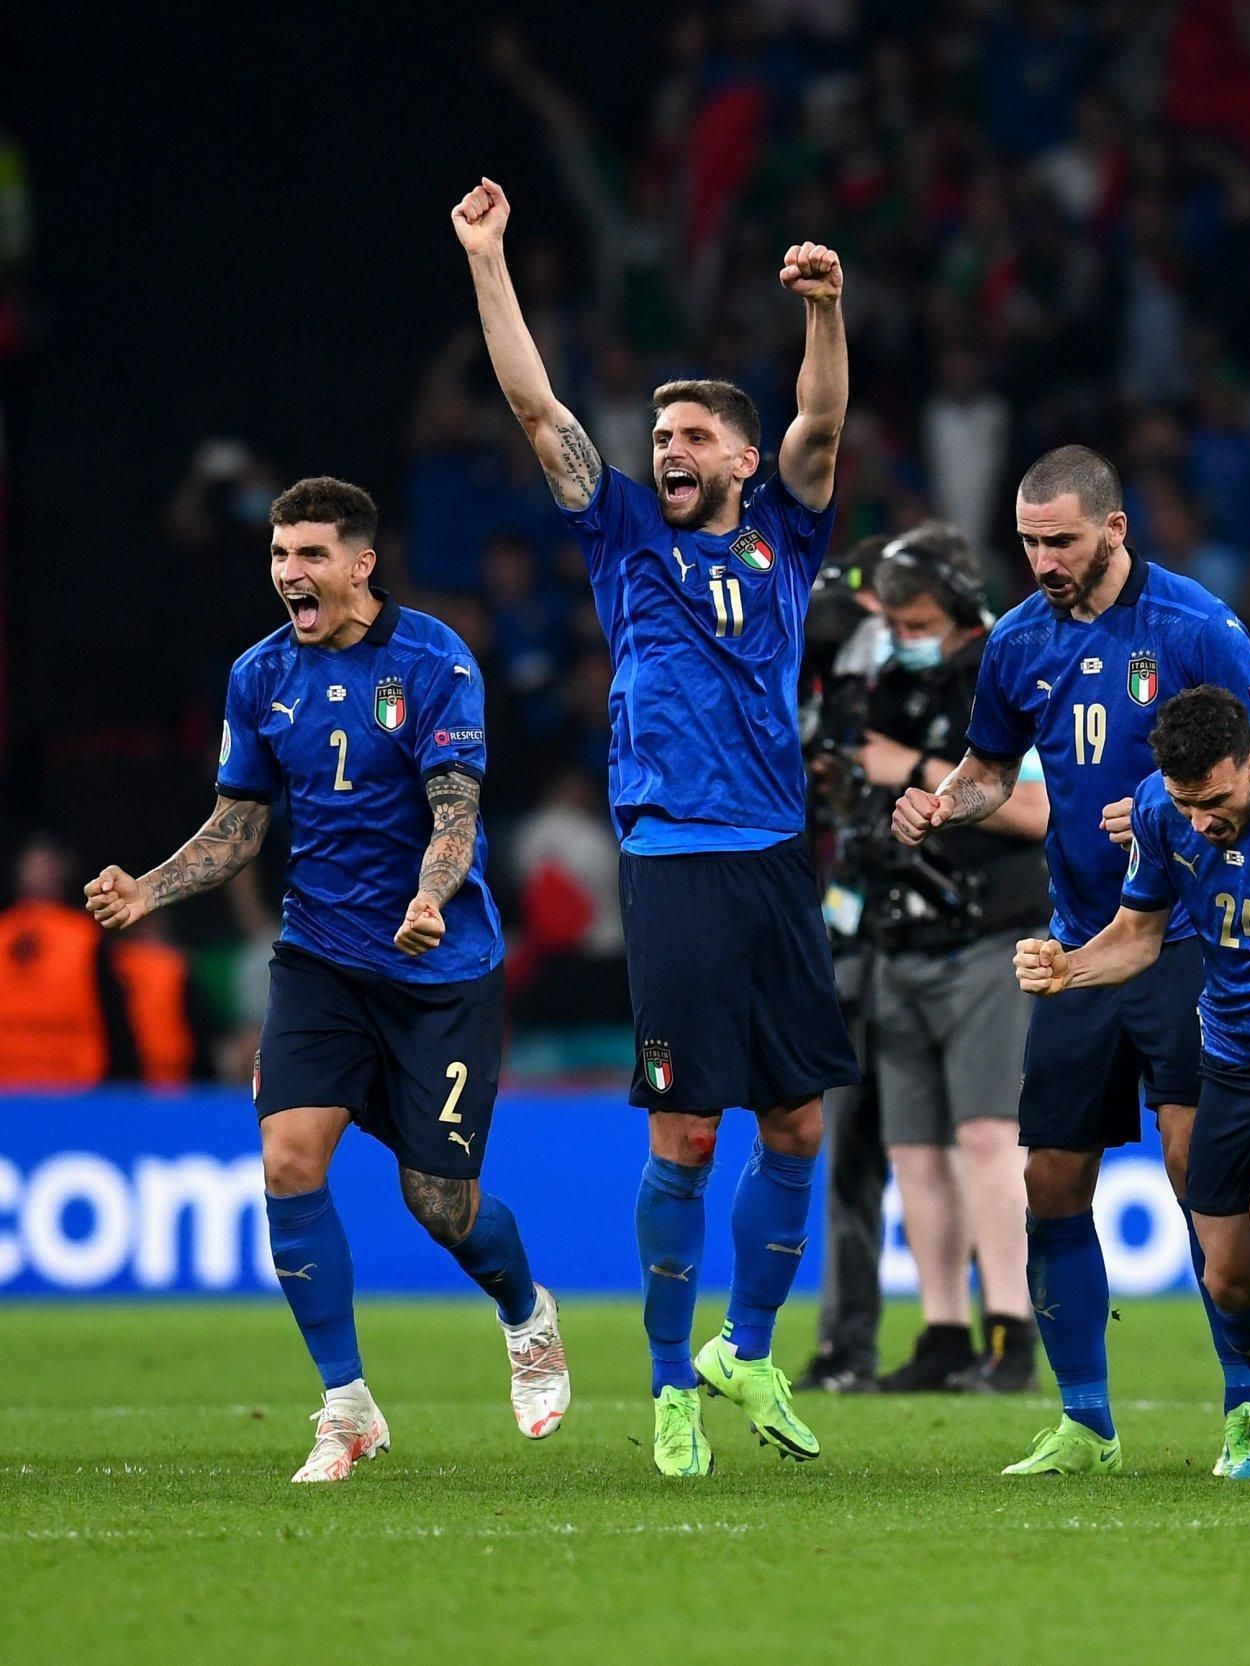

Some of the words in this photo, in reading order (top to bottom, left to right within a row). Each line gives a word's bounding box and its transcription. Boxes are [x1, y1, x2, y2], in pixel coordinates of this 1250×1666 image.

[733, 533, 758, 553] ITALIA
[709, 578, 744, 637] 11
[1131, 662, 1156, 670] ITALIA
[378, 688, 403, 697] ITALIA
[450, 731, 483, 740] RESPECT
[1073, 703, 1107, 765] 19
[329, 729, 353, 791] 2
[646, 1050, 669, 1058] ITALIA
[438, 1061, 468, 1124] 2
[0, 1152, 279, 1291] om
